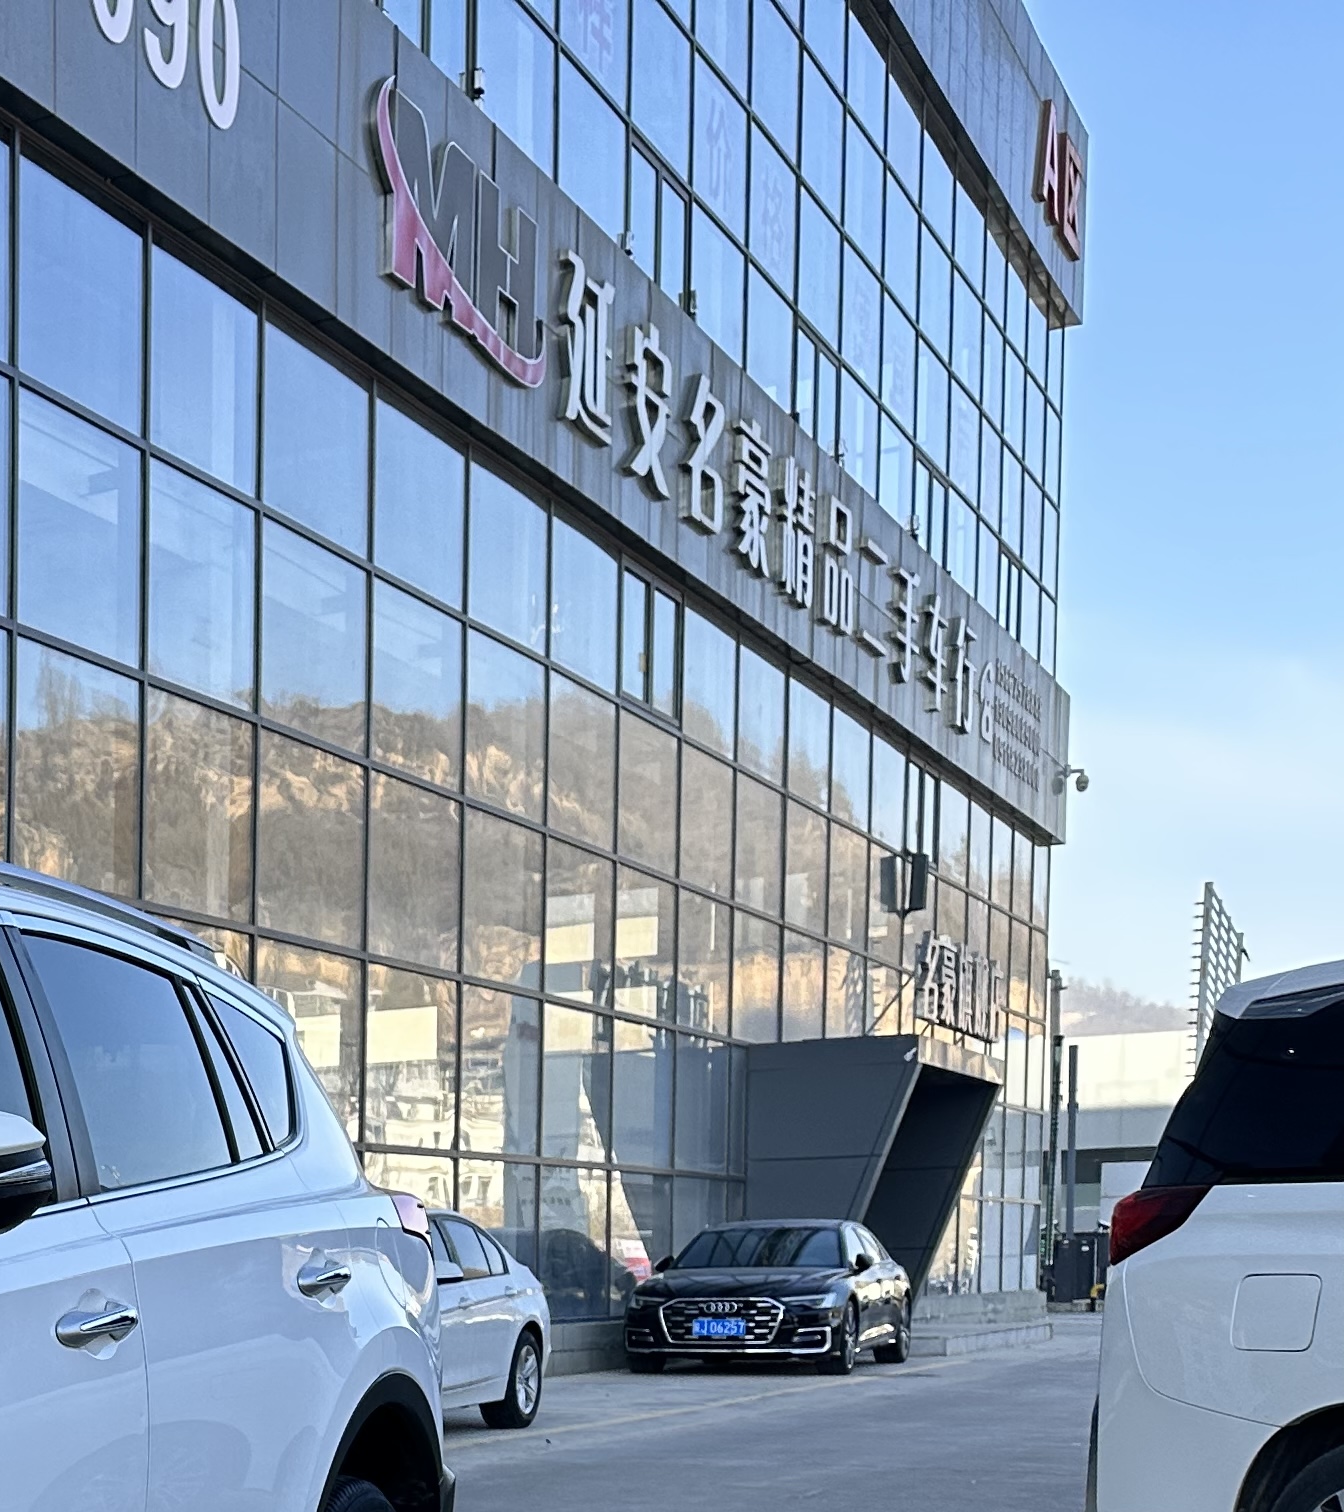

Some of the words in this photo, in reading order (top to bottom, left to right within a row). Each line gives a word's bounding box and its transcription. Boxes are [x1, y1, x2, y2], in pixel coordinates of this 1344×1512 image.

[561, 248, 978, 736] 延安名豪精品二手车行
